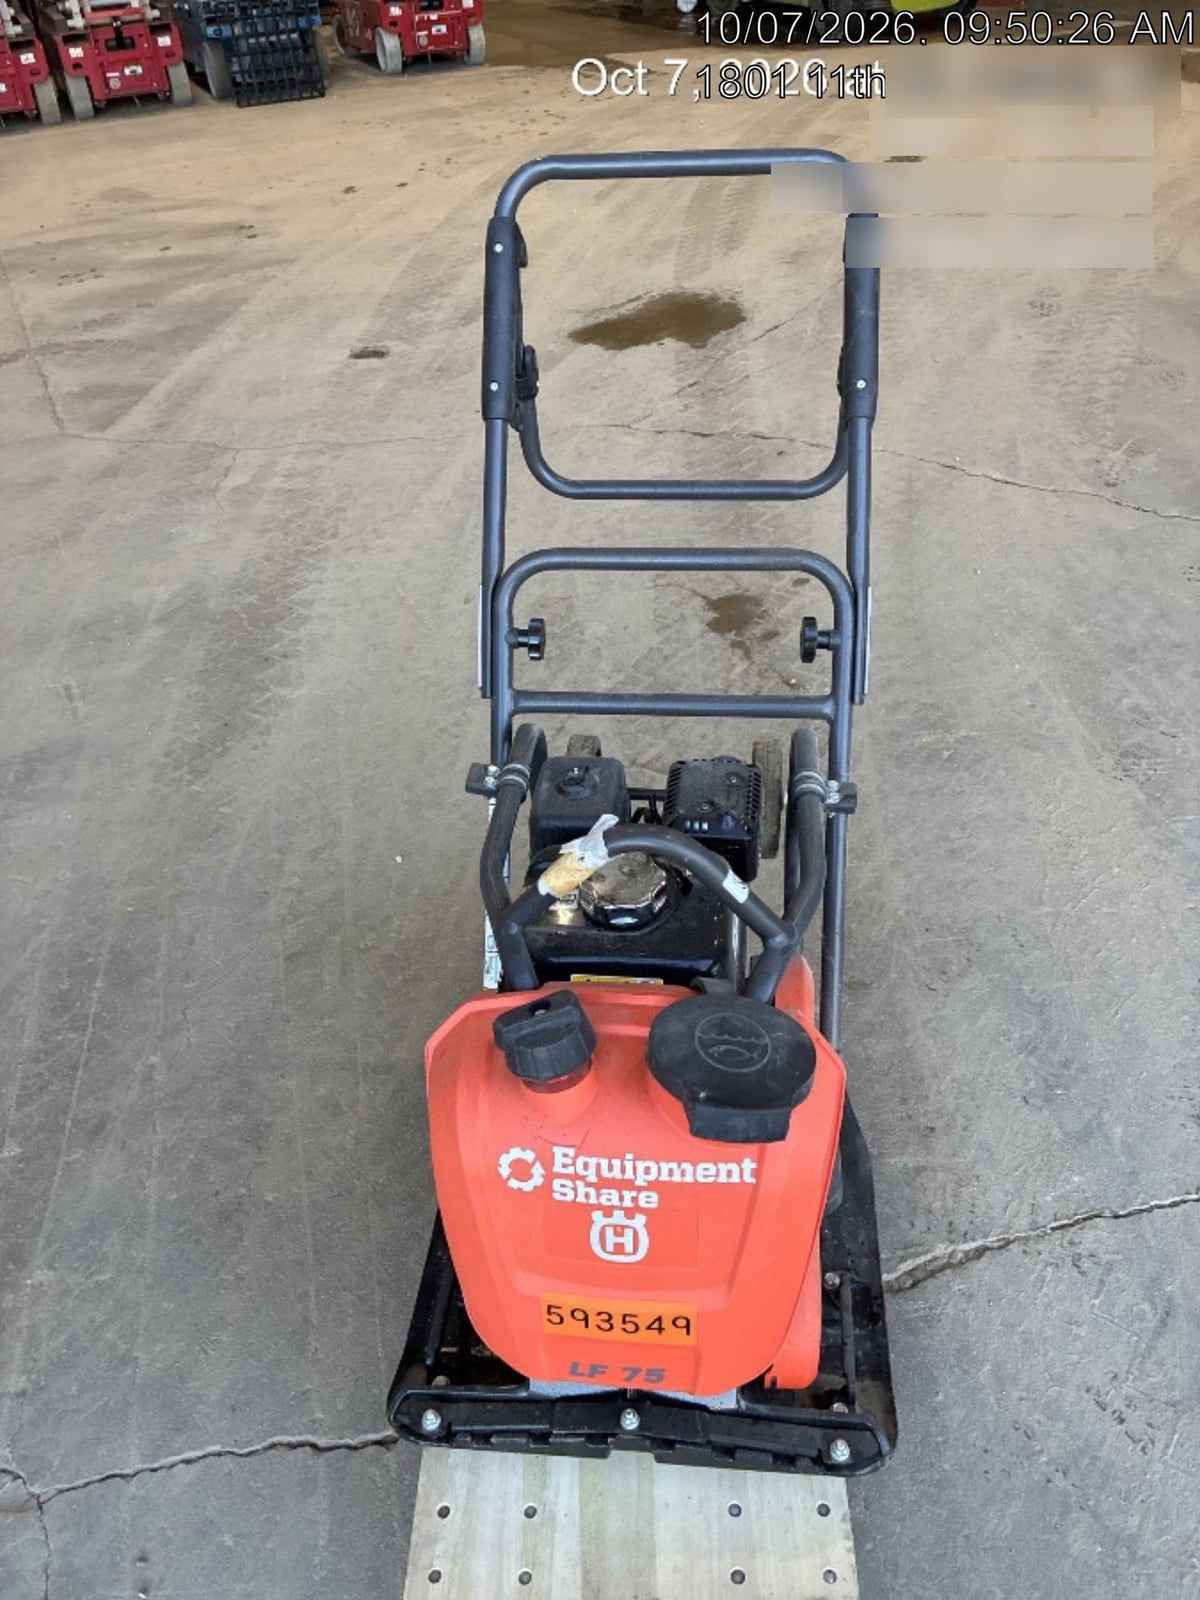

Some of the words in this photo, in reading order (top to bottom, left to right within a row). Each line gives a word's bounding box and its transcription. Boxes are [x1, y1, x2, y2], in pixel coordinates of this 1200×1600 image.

[552, 1146, 757, 1186] Equipment
[552, 1178, 659, 1209] Share
[546, 1304, 691, 1336] 593549
[568, 1361, 609, 1378] LF
[620, 1366, 666, 1384] 75
